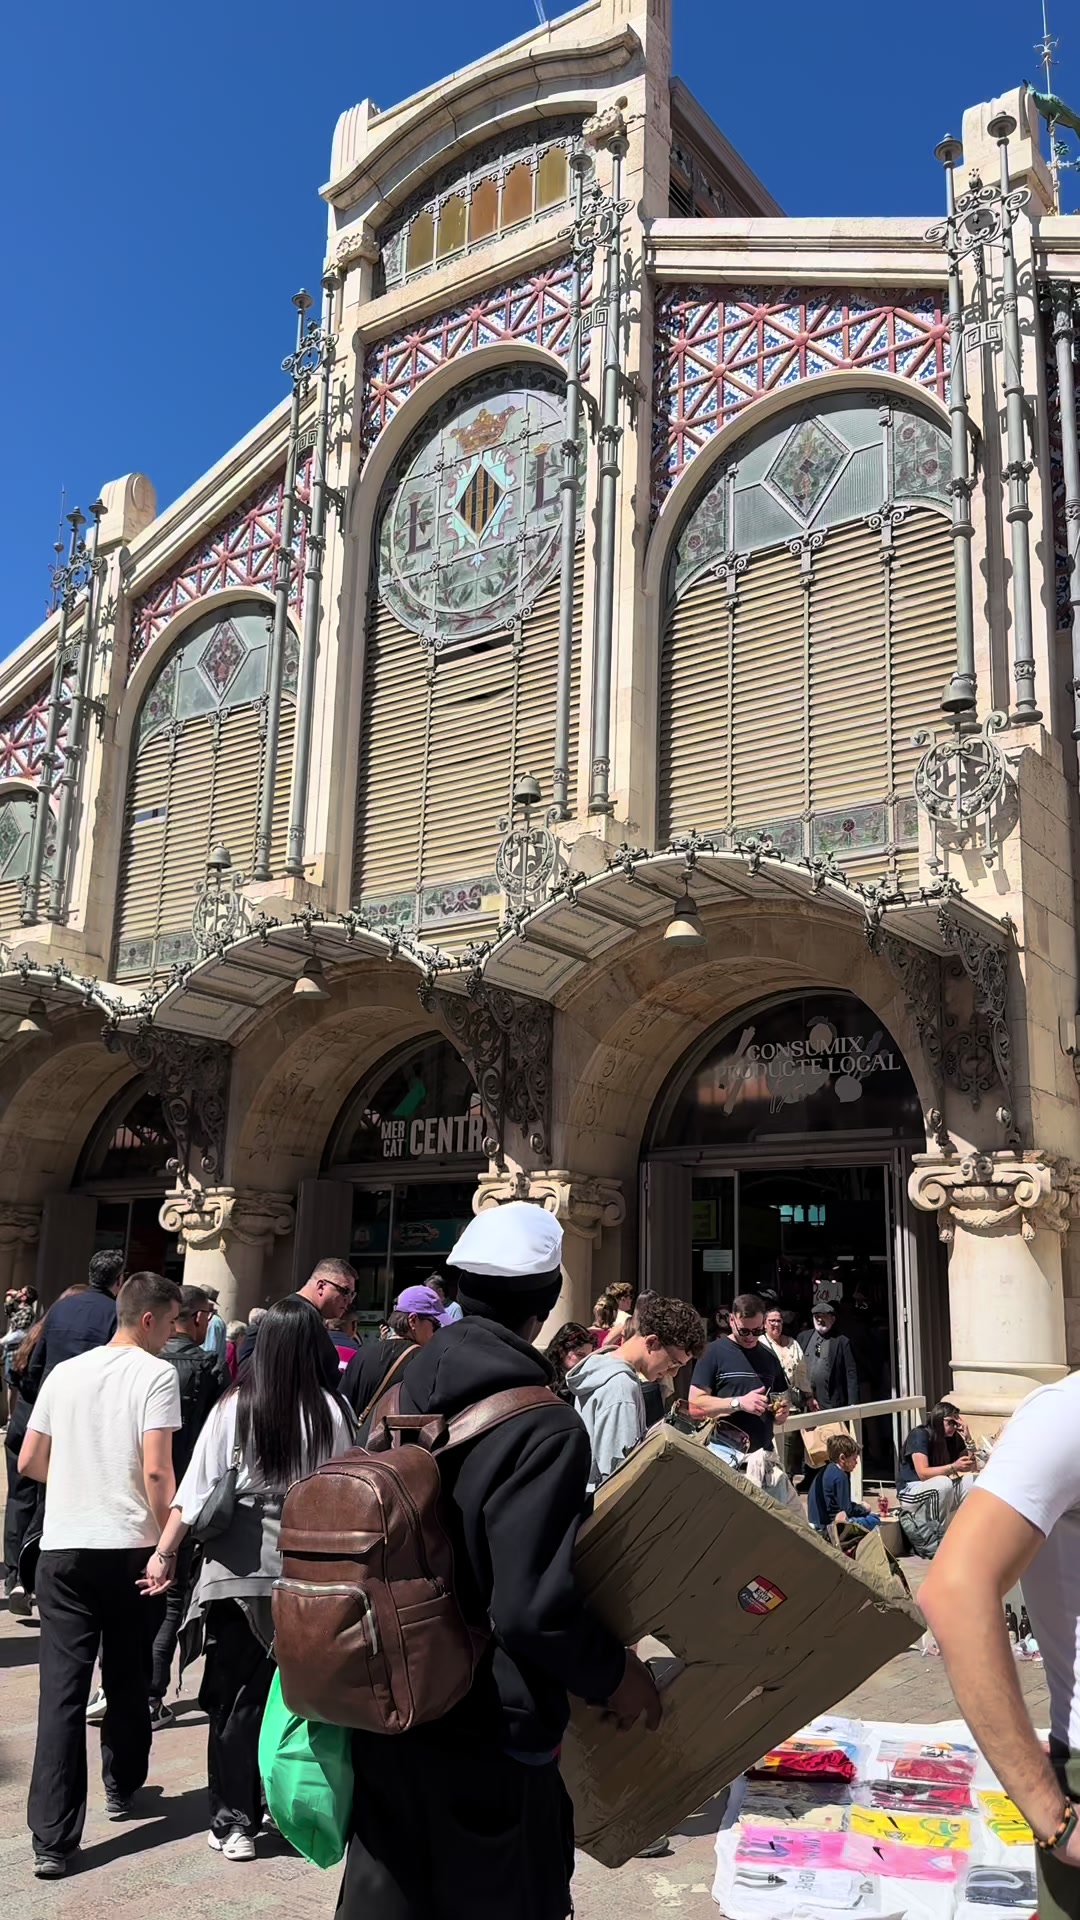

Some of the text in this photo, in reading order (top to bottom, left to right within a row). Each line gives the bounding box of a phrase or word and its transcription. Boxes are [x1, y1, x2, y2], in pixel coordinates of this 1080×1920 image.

[749, 1036, 863, 1061] CONSUMIX
[714, 1053, 901, 1082] PRODUCTE LOCAL
[381, 1120, 405, 1139] MER
[383, 1139, 405, 1157] CAT
